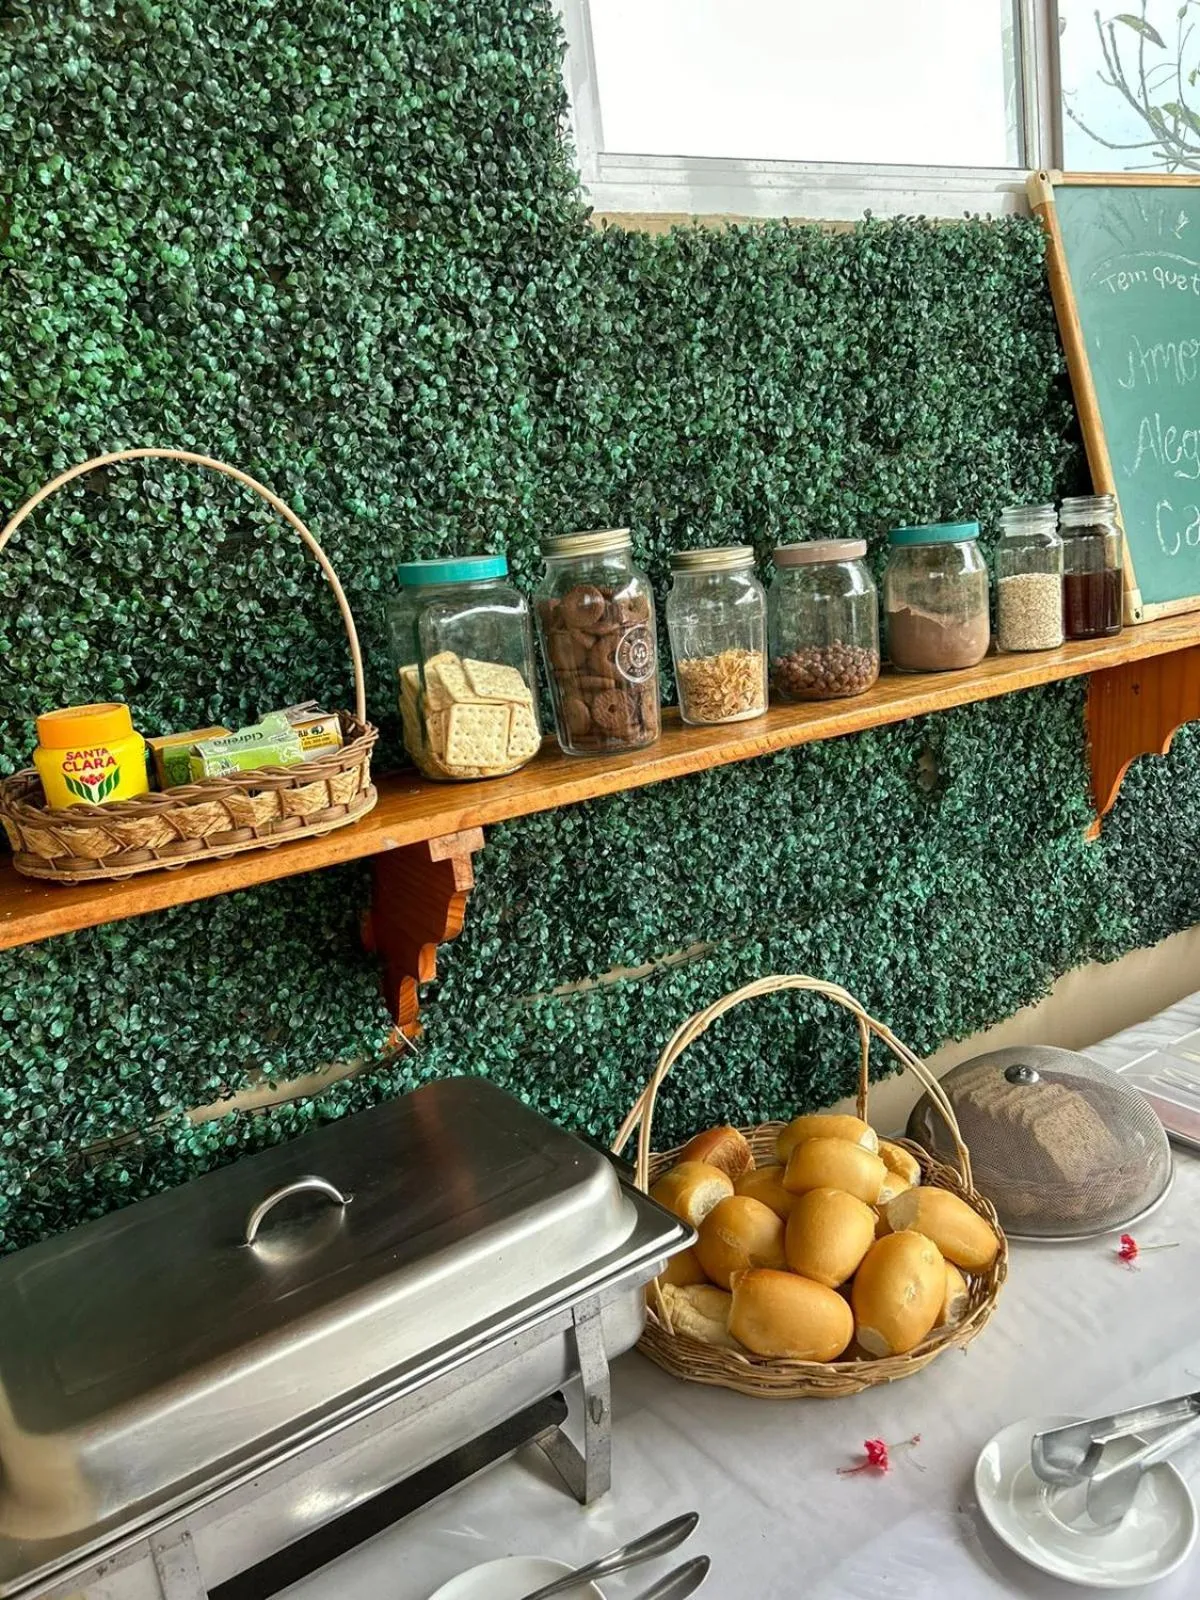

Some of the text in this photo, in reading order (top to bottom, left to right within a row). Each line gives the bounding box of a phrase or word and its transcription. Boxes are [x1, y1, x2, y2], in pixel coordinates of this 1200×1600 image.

[1099, 271, 1148, 293] Tem
[1122, 412, 1200, 479] Aleg
[66, 748, 109, 761] SANTA
[62, 756, 117, 773] CLARA
